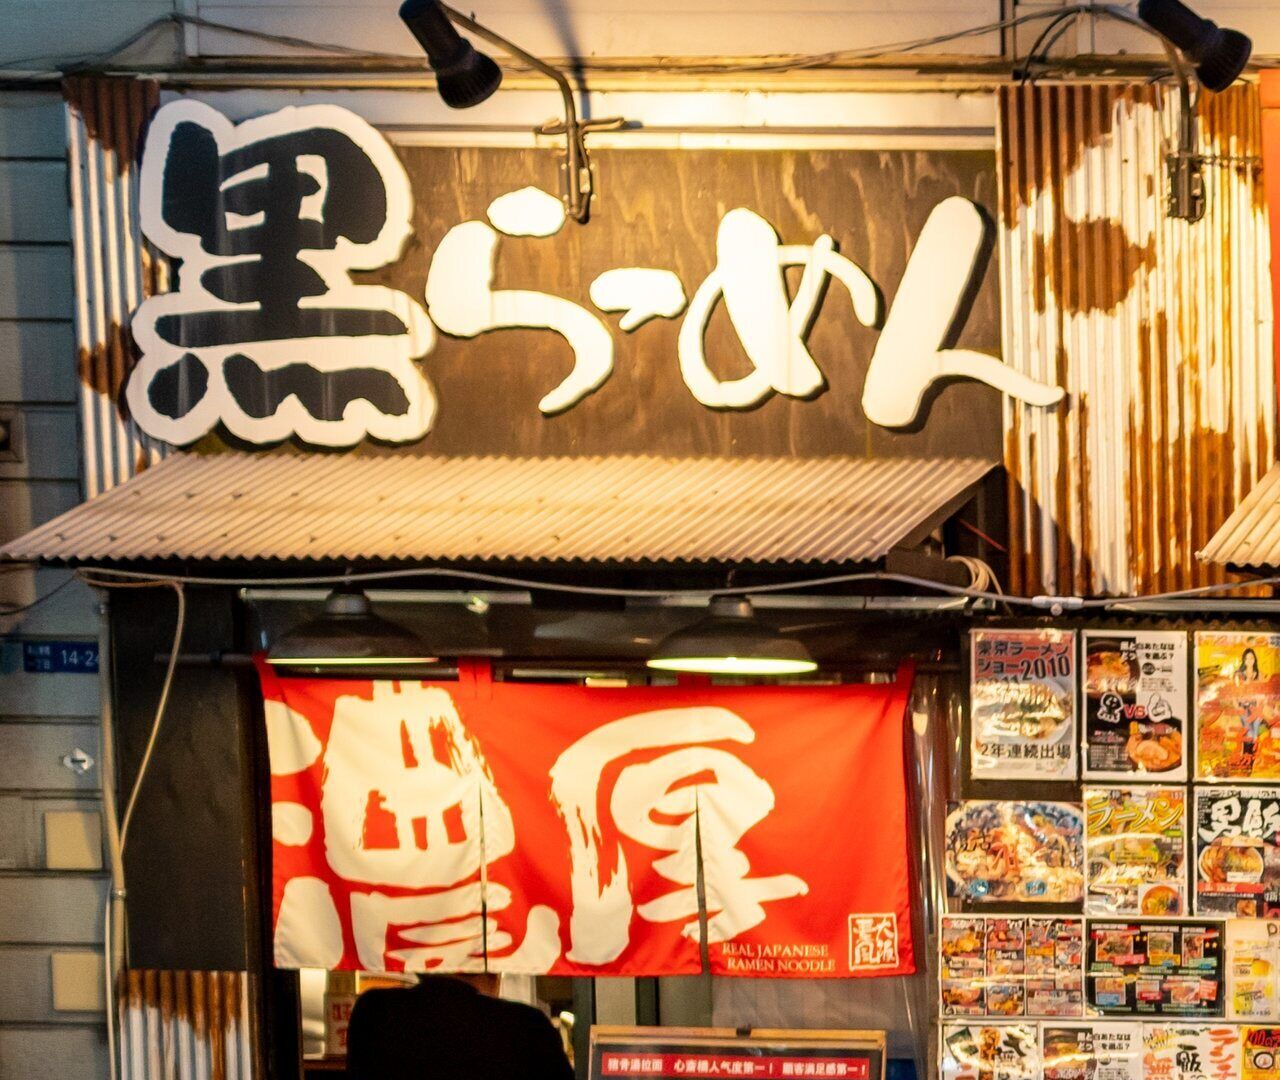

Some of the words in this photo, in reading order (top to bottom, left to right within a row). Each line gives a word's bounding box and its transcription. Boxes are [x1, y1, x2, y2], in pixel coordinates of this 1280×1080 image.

[981, 743, 1071, 759] 2年連続出場
[265, 680, 810, 976] 濃厚
[722, 942, 754, 955] REAL
[757, 944, 829, 958] JAPANESE
[728, 959, 774, 971] RAMEN
[778, 959, 835, 972] NOODLE
